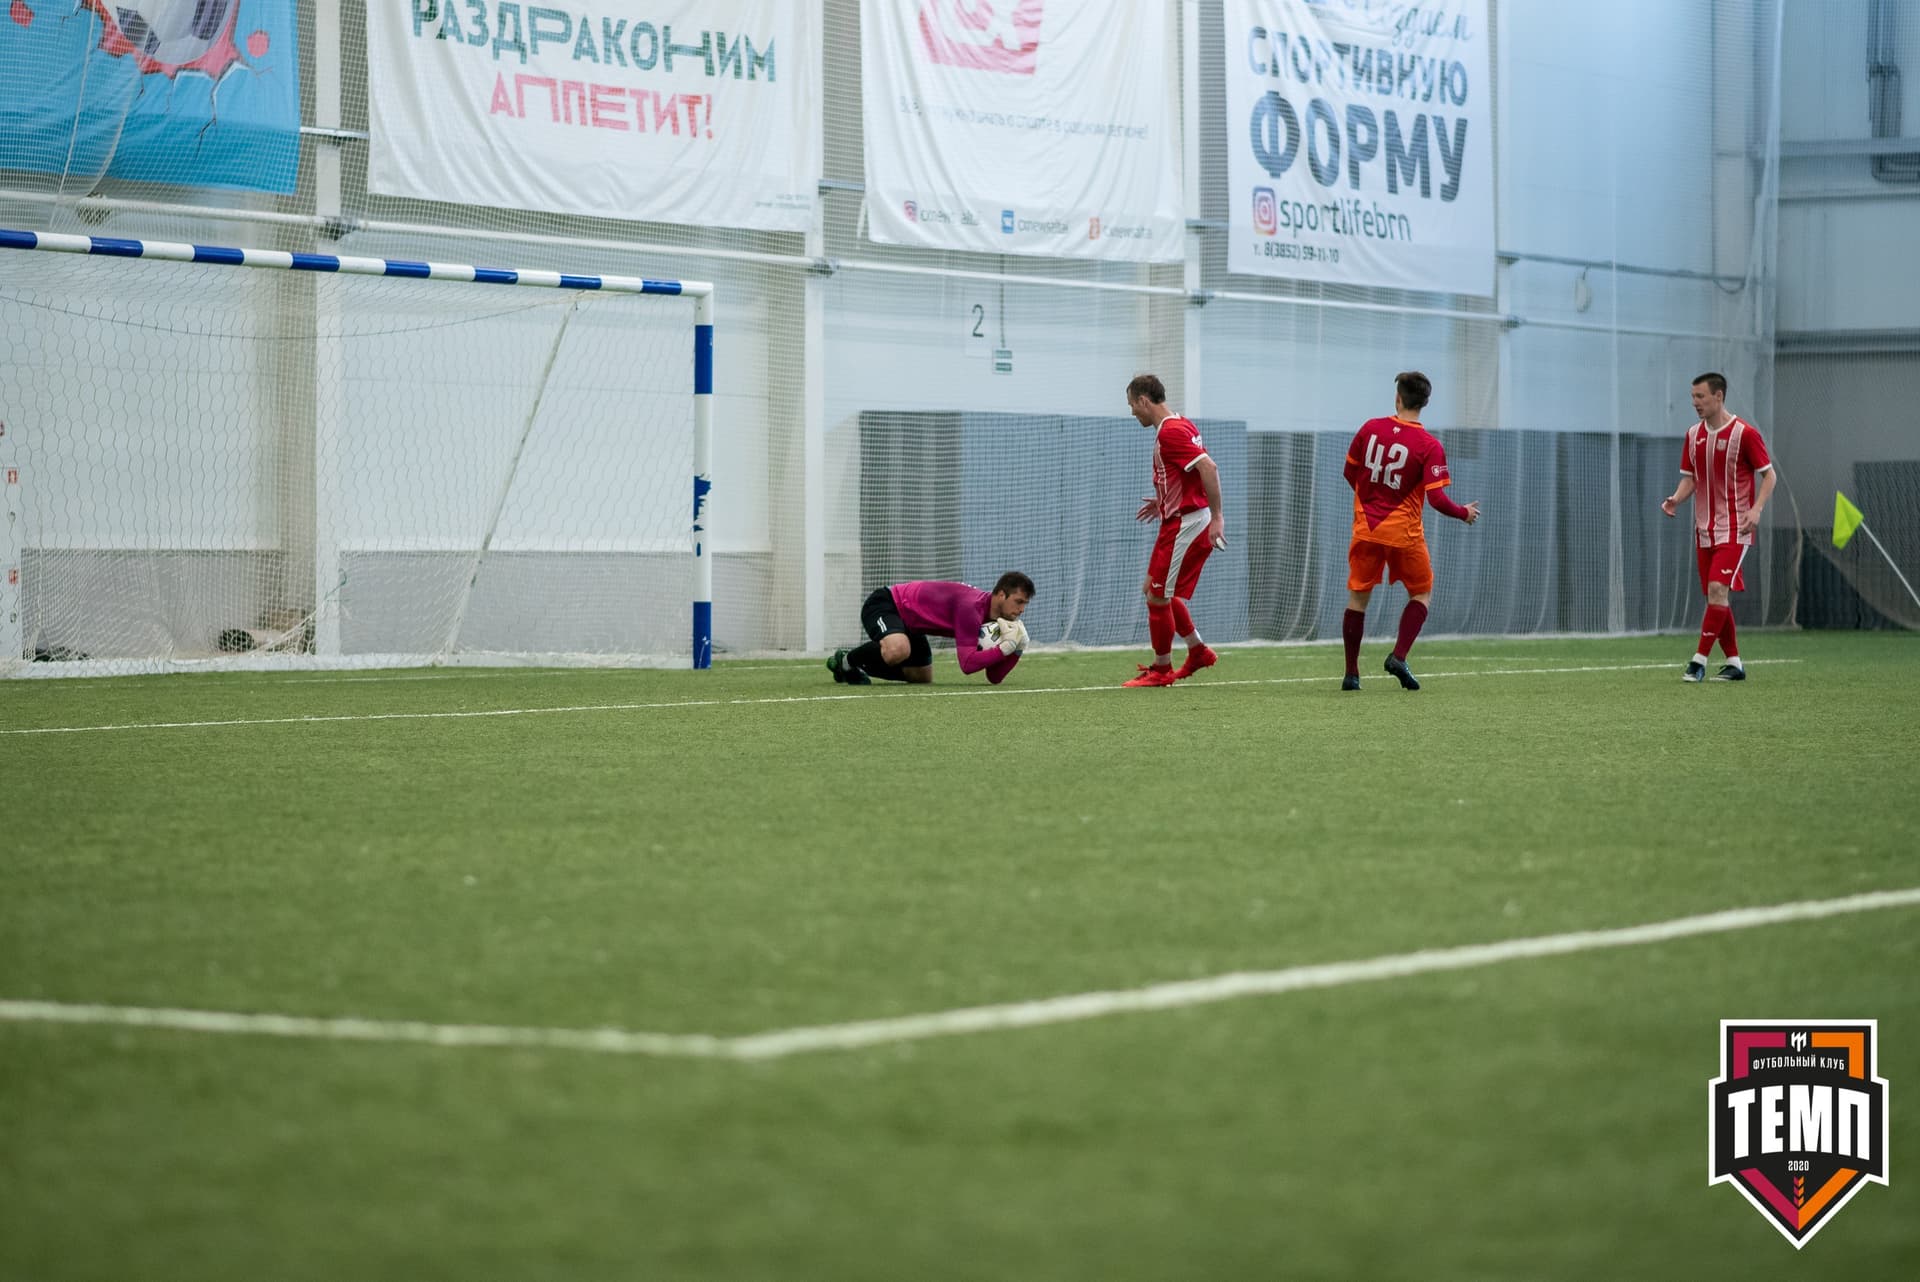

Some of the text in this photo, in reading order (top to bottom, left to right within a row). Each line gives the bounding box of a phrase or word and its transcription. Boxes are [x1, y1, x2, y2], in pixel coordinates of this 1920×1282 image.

[411, 0, 776, 82] РАЗДРАКОНИМ
[1248, 26, 1468, 107] СПОРТИВНУЮ
[489, 71, 713, 140] АППЕТИТ!
[1250, 90, 1468, 203] ФОРМУ
[1280, 198, 1412, 242] sportlifebrn
[972, 304, 984, 338] 2
[1365, 434, 1409, 490] 42
